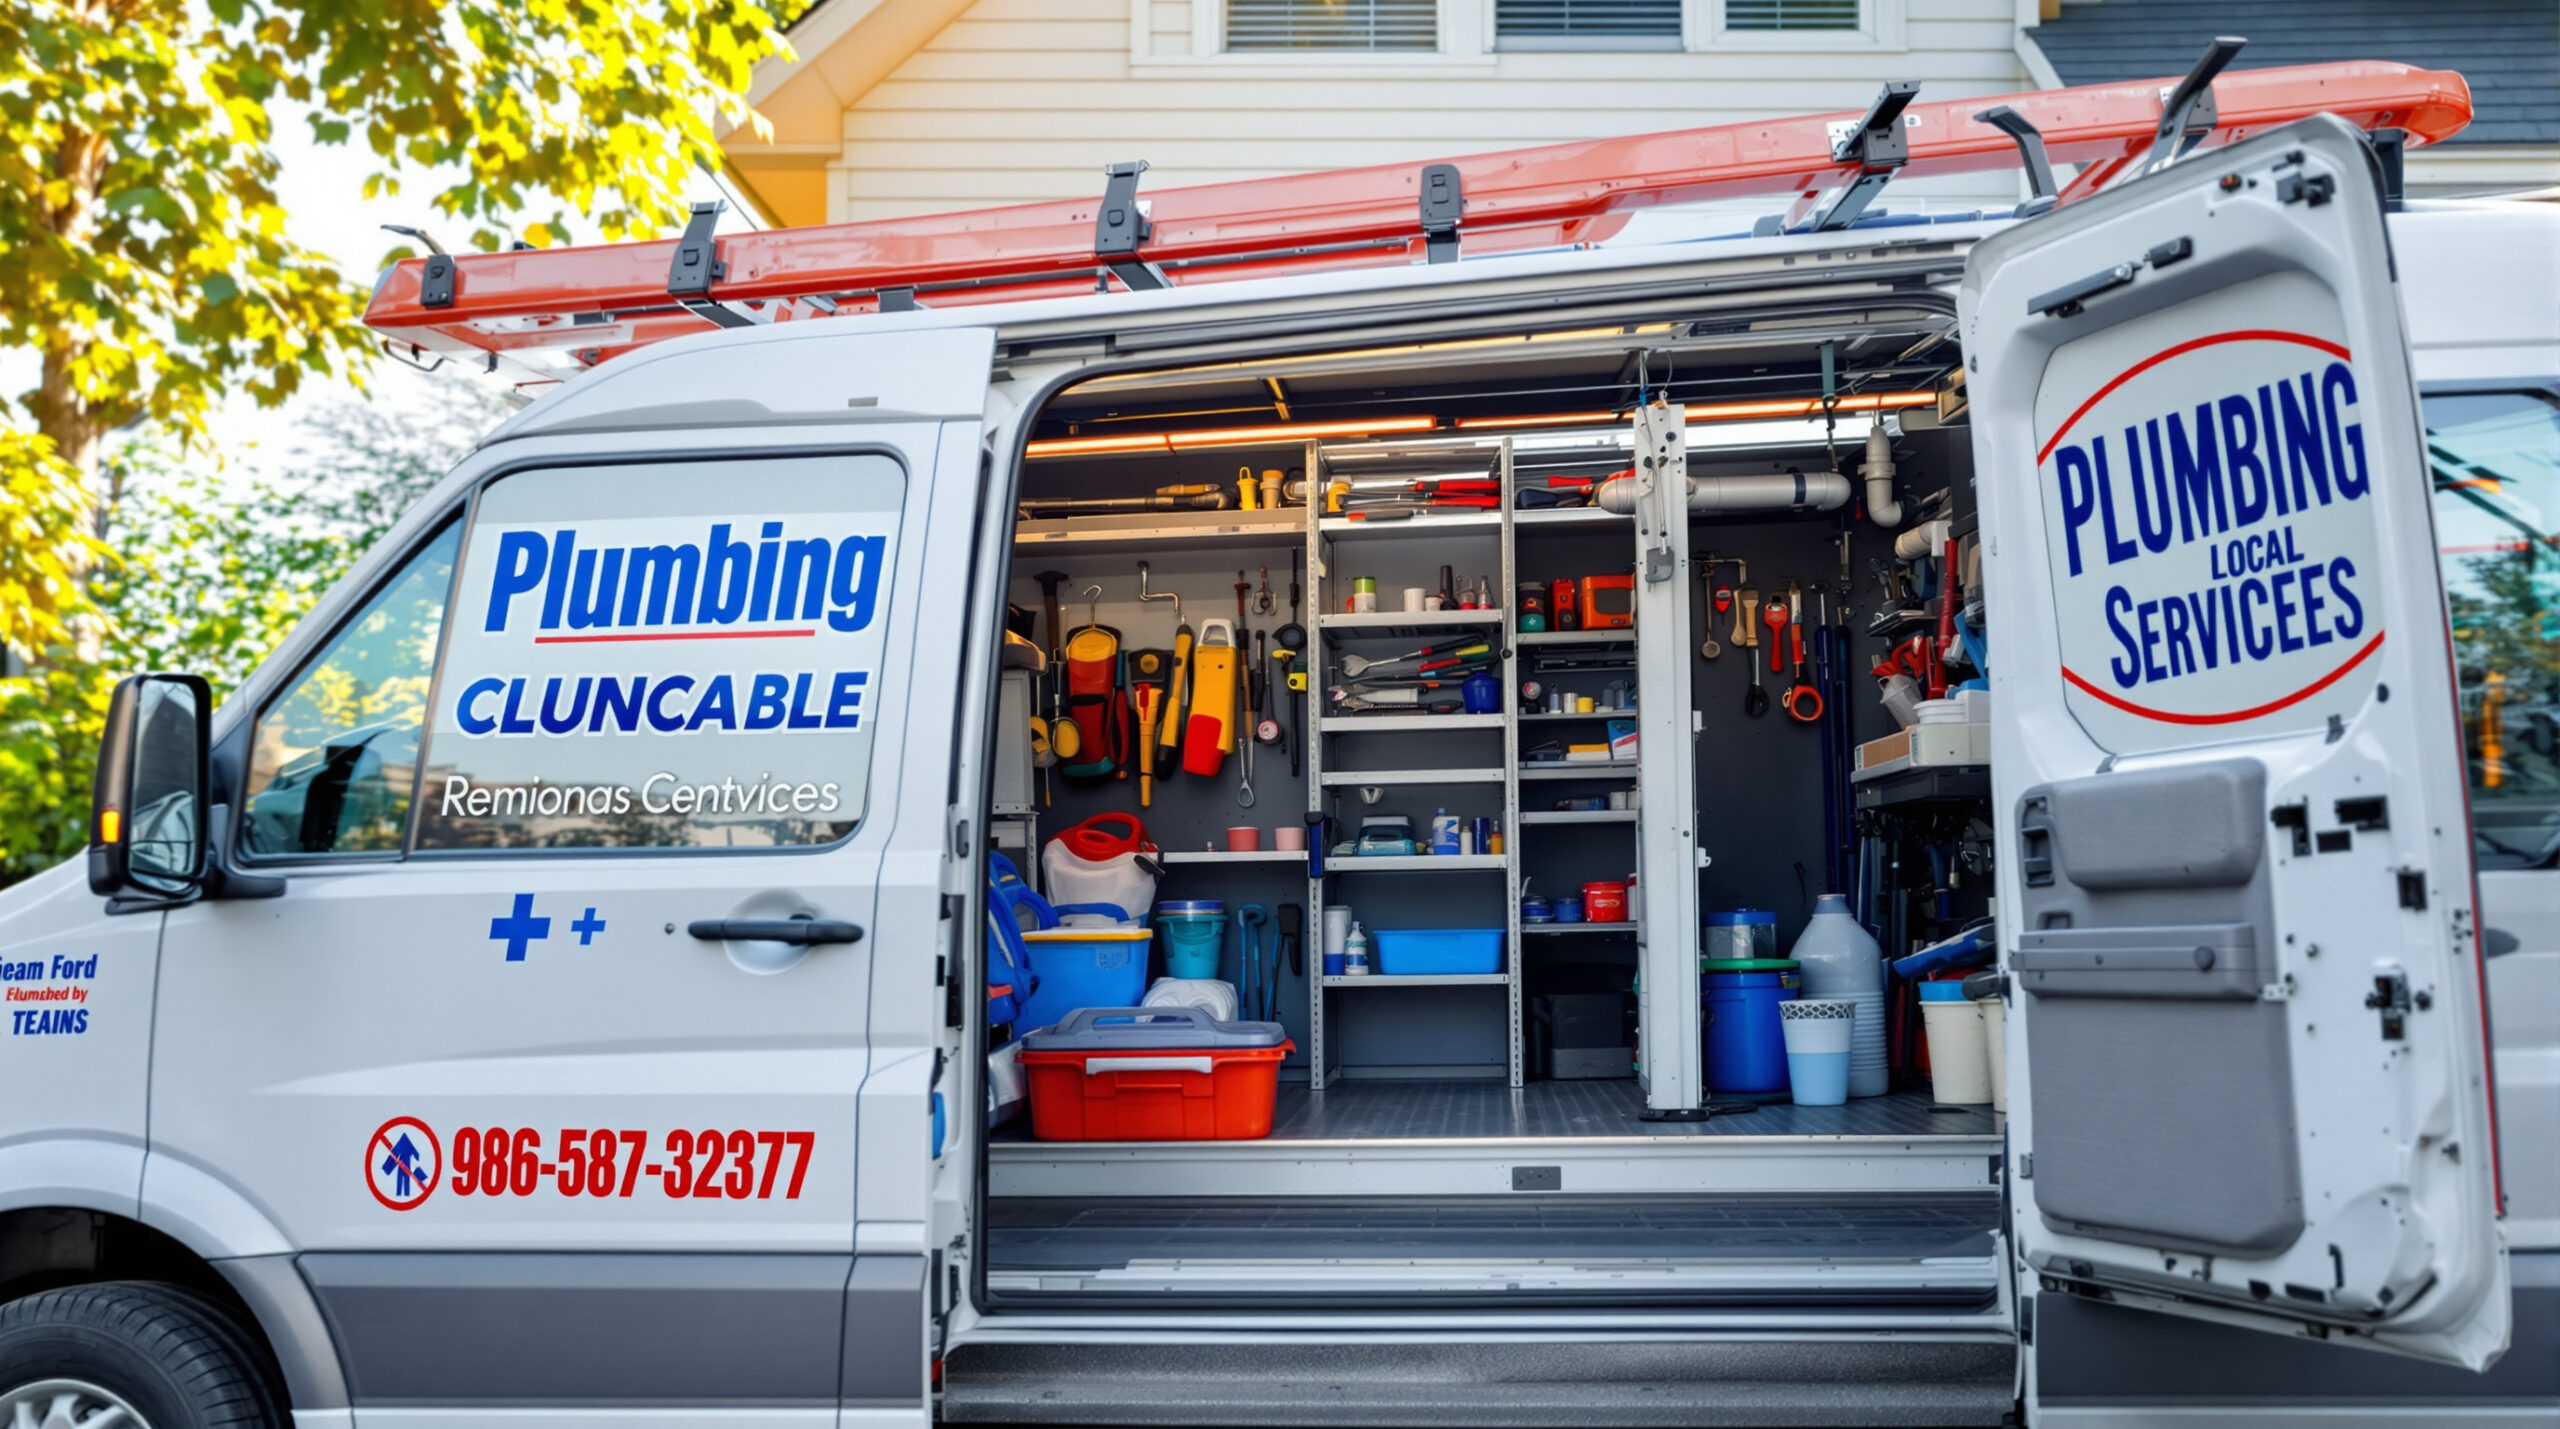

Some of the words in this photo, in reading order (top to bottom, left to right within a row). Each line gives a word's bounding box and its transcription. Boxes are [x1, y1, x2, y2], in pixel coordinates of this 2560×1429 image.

[2055, 362, 2370, 577] PLUMBING
[485, 521, 887, 633] Plumbing
[2210, 525, 2305, 581] LOCAL
[456, 671, 869, 735] CLUNCABLE
[441, 774, 631, 817] Remionas
[641, 772, 840, 814] Centvices
[50, 953, 99, 980] Ford
[13, 1008, 90, 1036] TEAINS
[71, 986, 88, 1004] by
[451, 1126, 816, 1200] 986-587-32377
